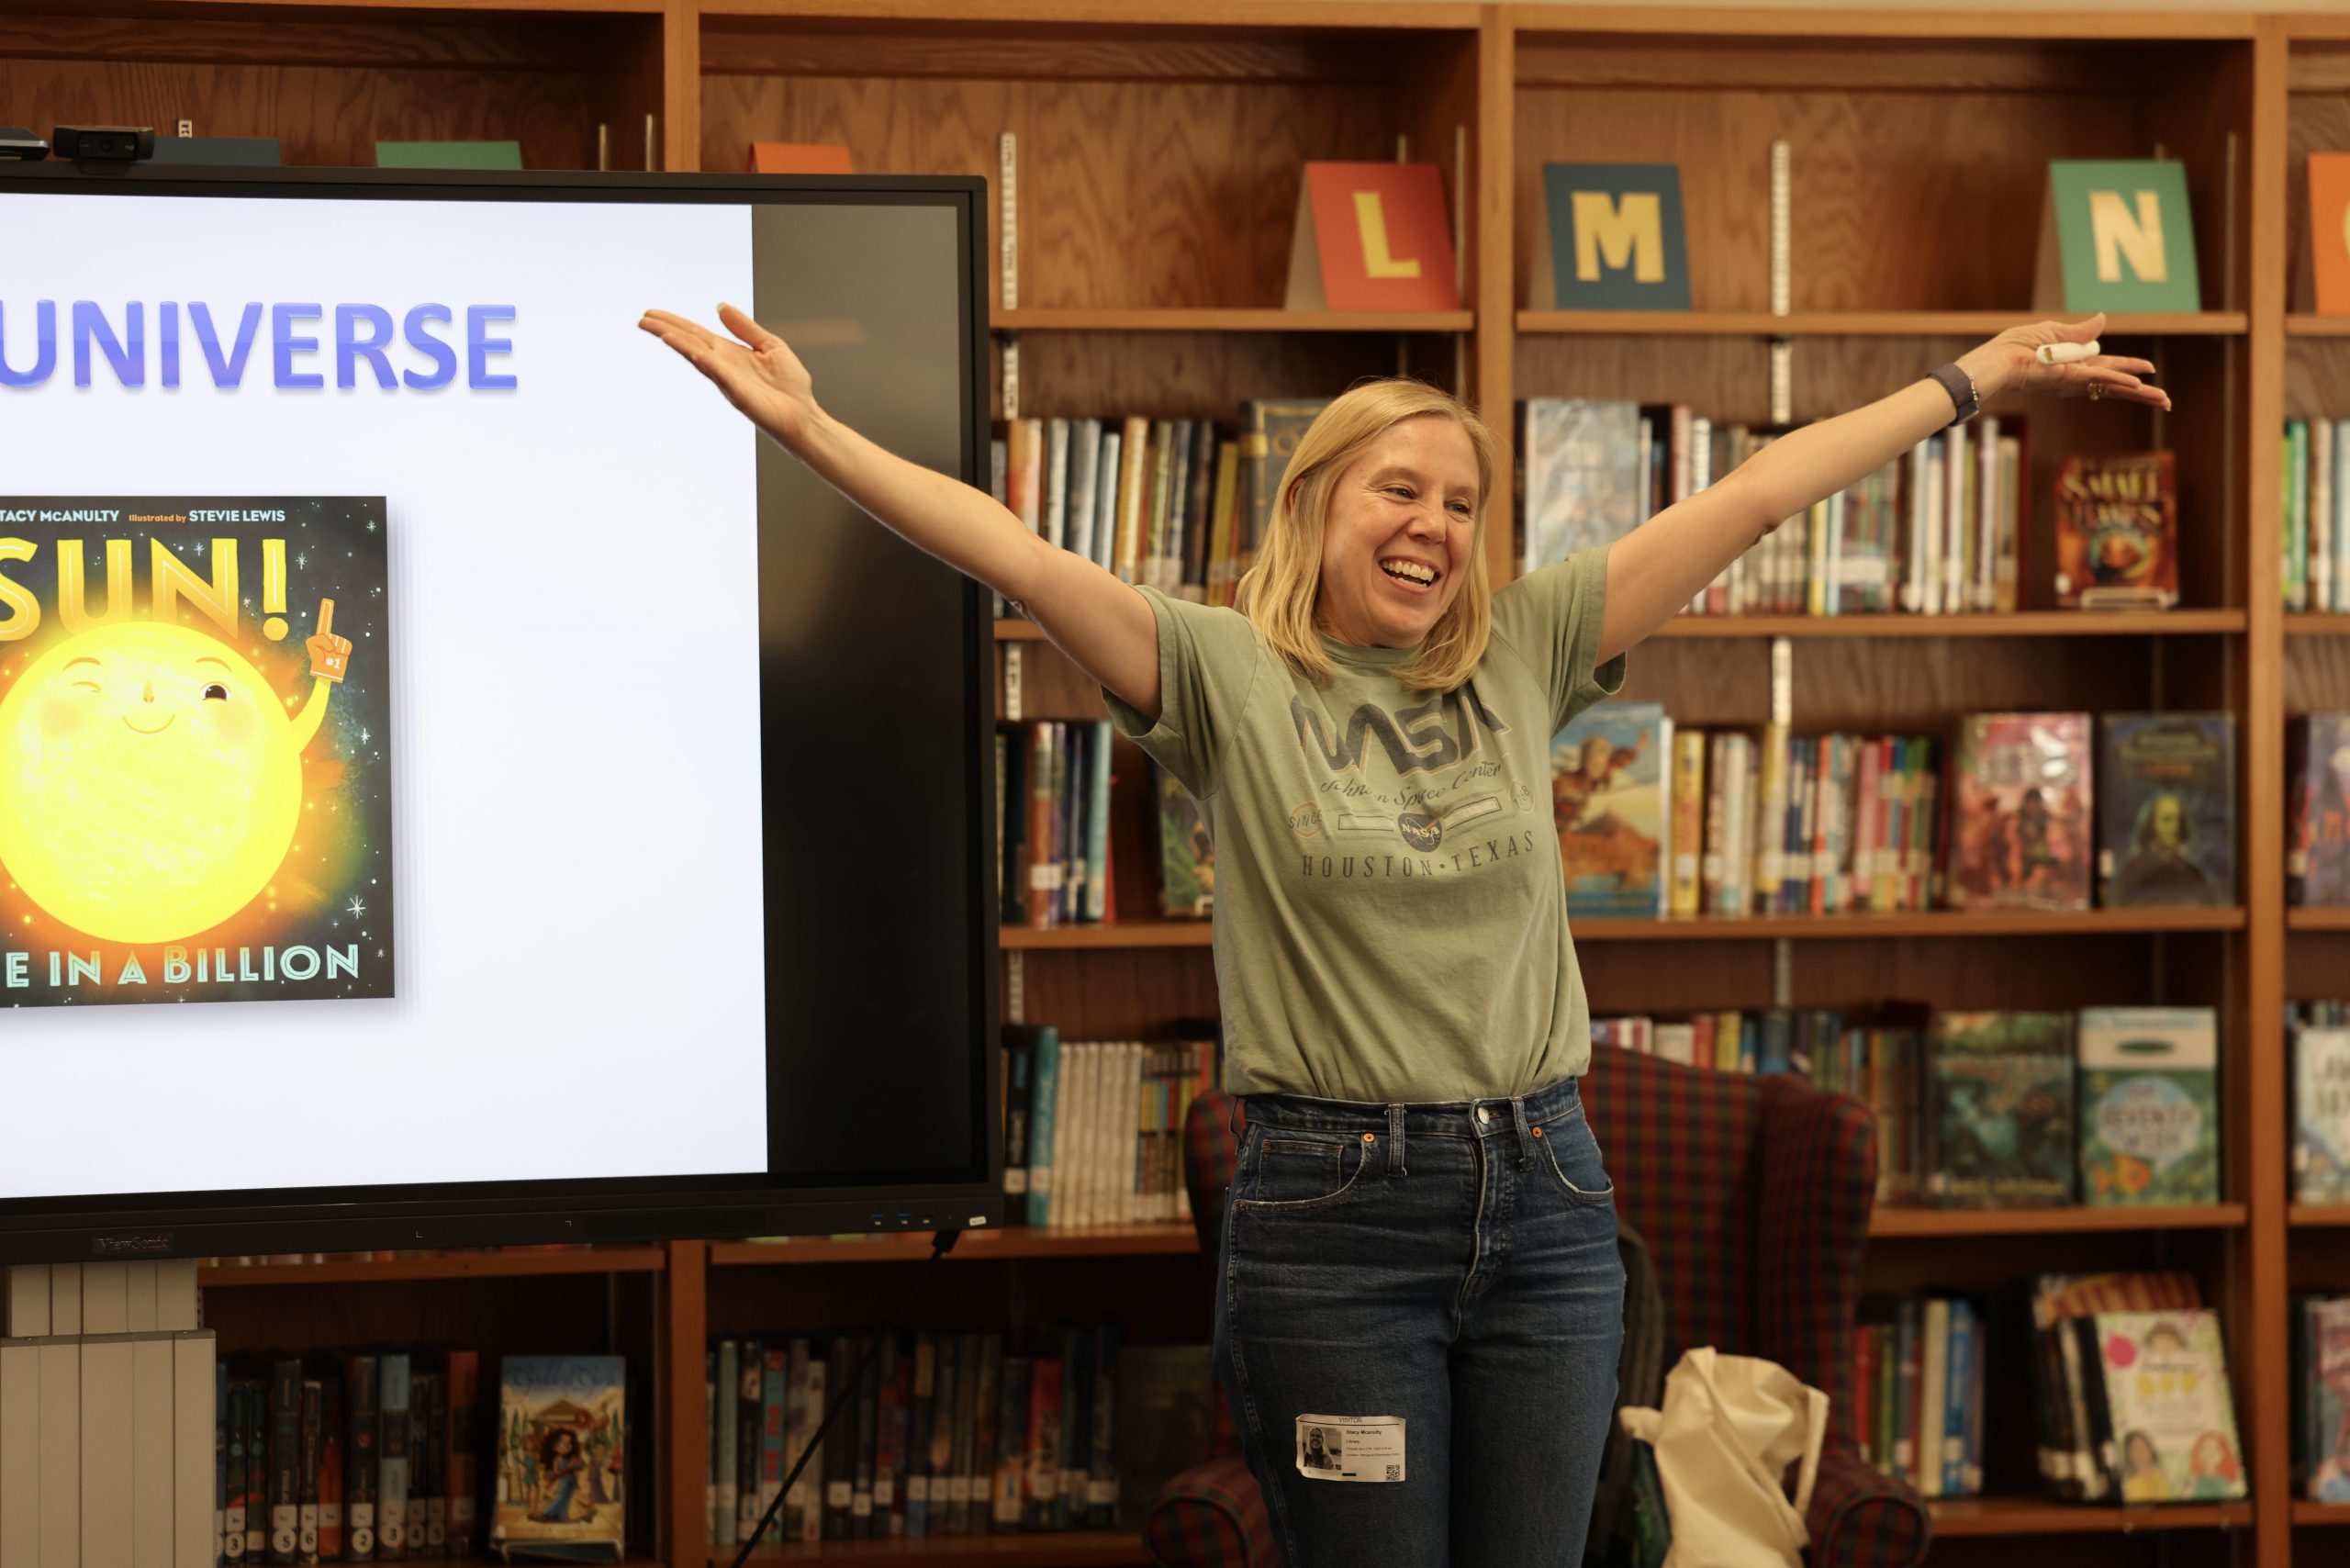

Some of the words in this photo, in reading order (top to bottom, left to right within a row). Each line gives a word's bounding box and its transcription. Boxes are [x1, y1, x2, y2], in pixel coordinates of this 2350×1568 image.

[1353, 190, 1421, 279] L
[1571, 191, 1665, 283] M
[2088, 190, 2167, 283] N
[0, 299, 518, 390] UNIVERSE
[129, 514, 173, 522] Illustrated
[175, 515, 186, 523] by
[189, 510, 240, 522] STEVIE
[242, 510, 286, 522] LEWIS
[0, 537, 288, 642] SUN!
[326, 657, 341, 669] #1
[1290, 681, 1513, 778] NASA
[1393, 786, 1448, 811] Space
[1401, 823, 1440, 838] NASA
[1302, 856, 1433, 878] HOUSTON
[1450, 830, 1534, 872] TEXAS
[50, 950, 101, 986] IN
[118, 950, 147, 984] A
[163, 944, 359, 984] BILLION
